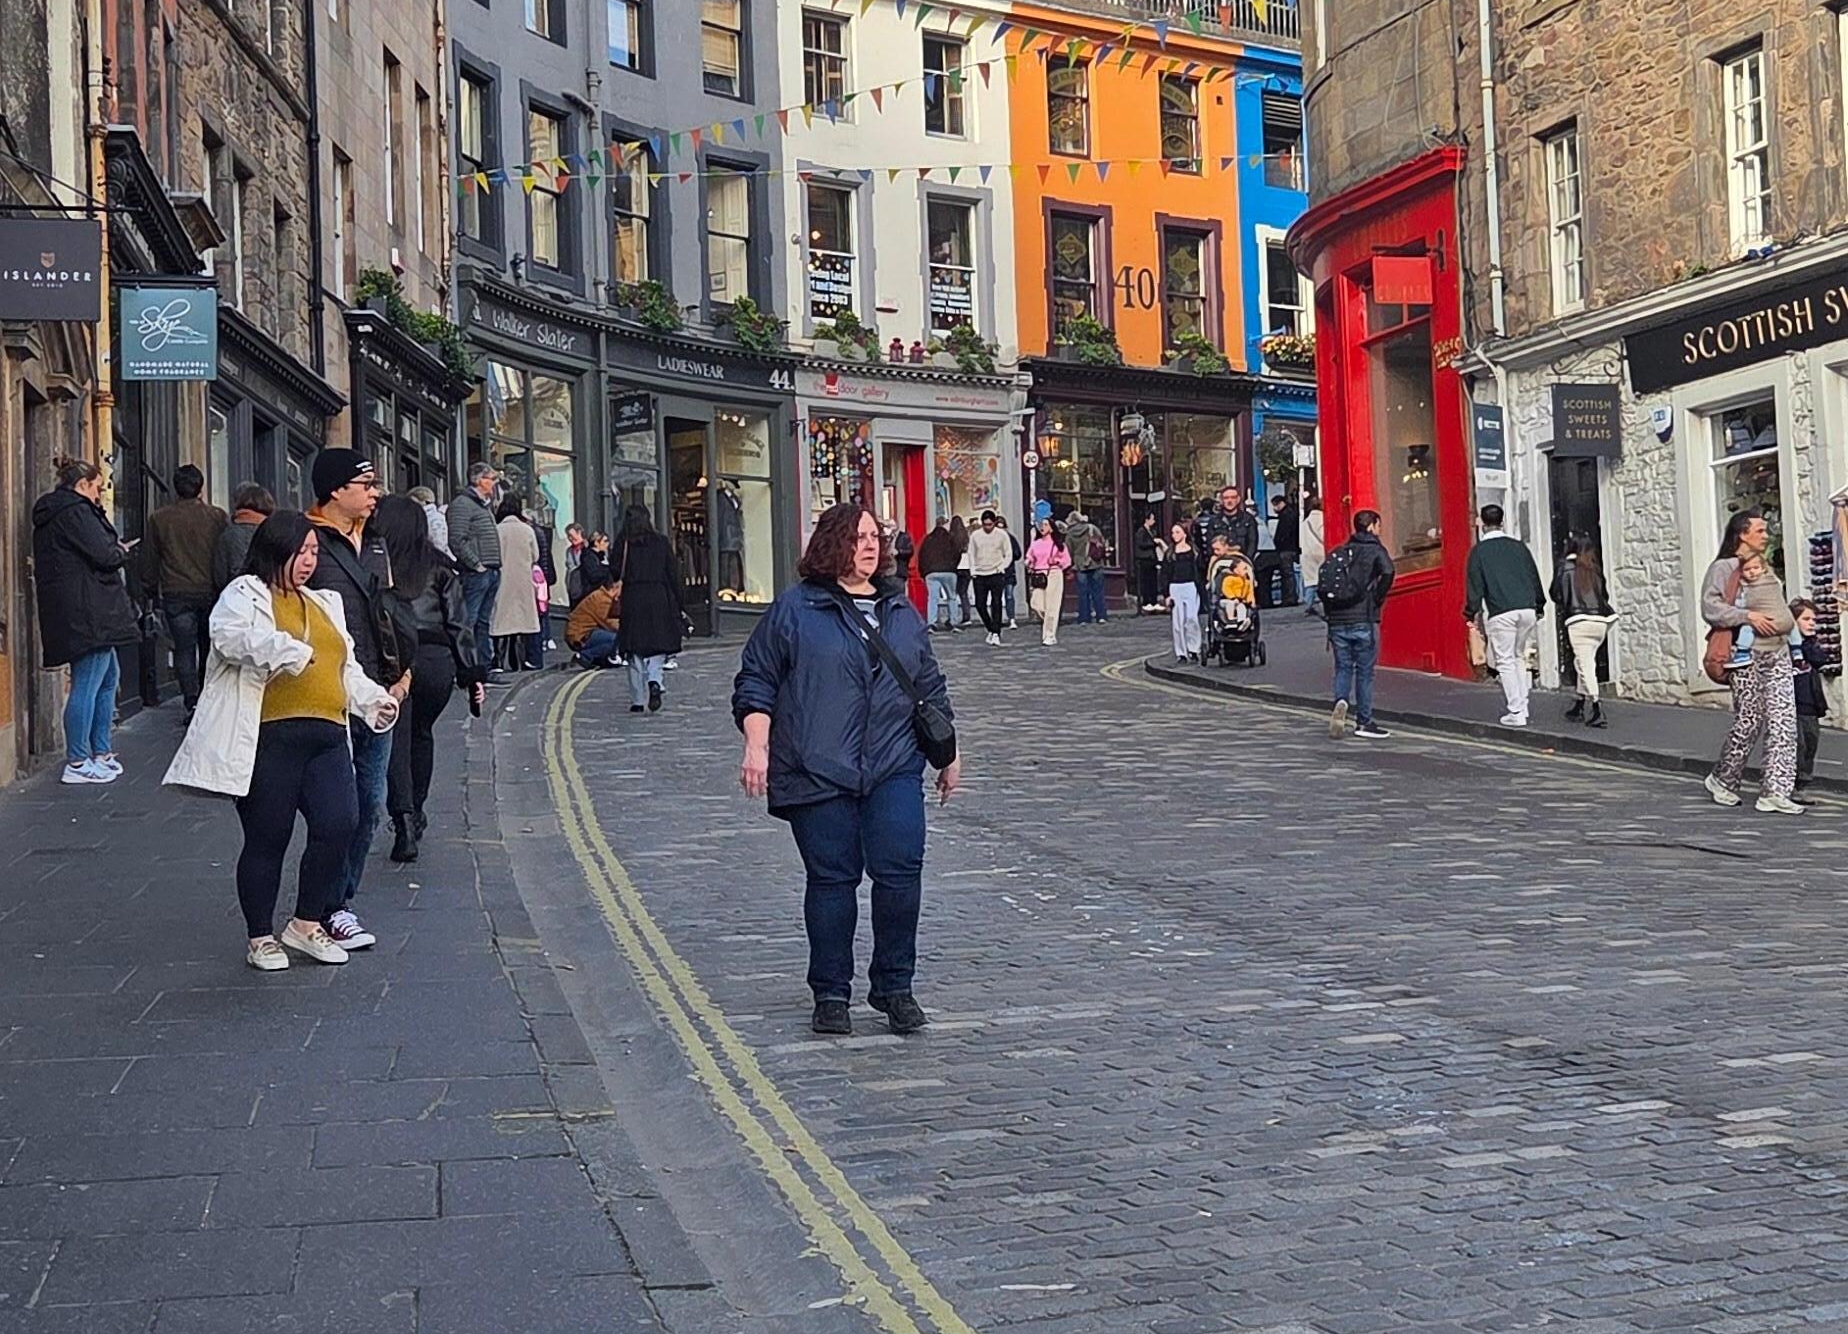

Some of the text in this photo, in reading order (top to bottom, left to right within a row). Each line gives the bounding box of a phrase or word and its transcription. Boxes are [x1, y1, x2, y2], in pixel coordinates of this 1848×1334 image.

[3, 269, 92, 282] ISLANDER
[1114, 265, 1156, 310] 40
[536, 322, 576, 351] Slater
[1682, 296, 1815, 365] SCOTTISH
[657, 354, 725, 380] LADIESWEAR
[1562, 398, 1612, 411] SCOTTISH
[1567, 414, 1608, 425] SWEETS
[1564, 428, 1612, 440] & TREATS
